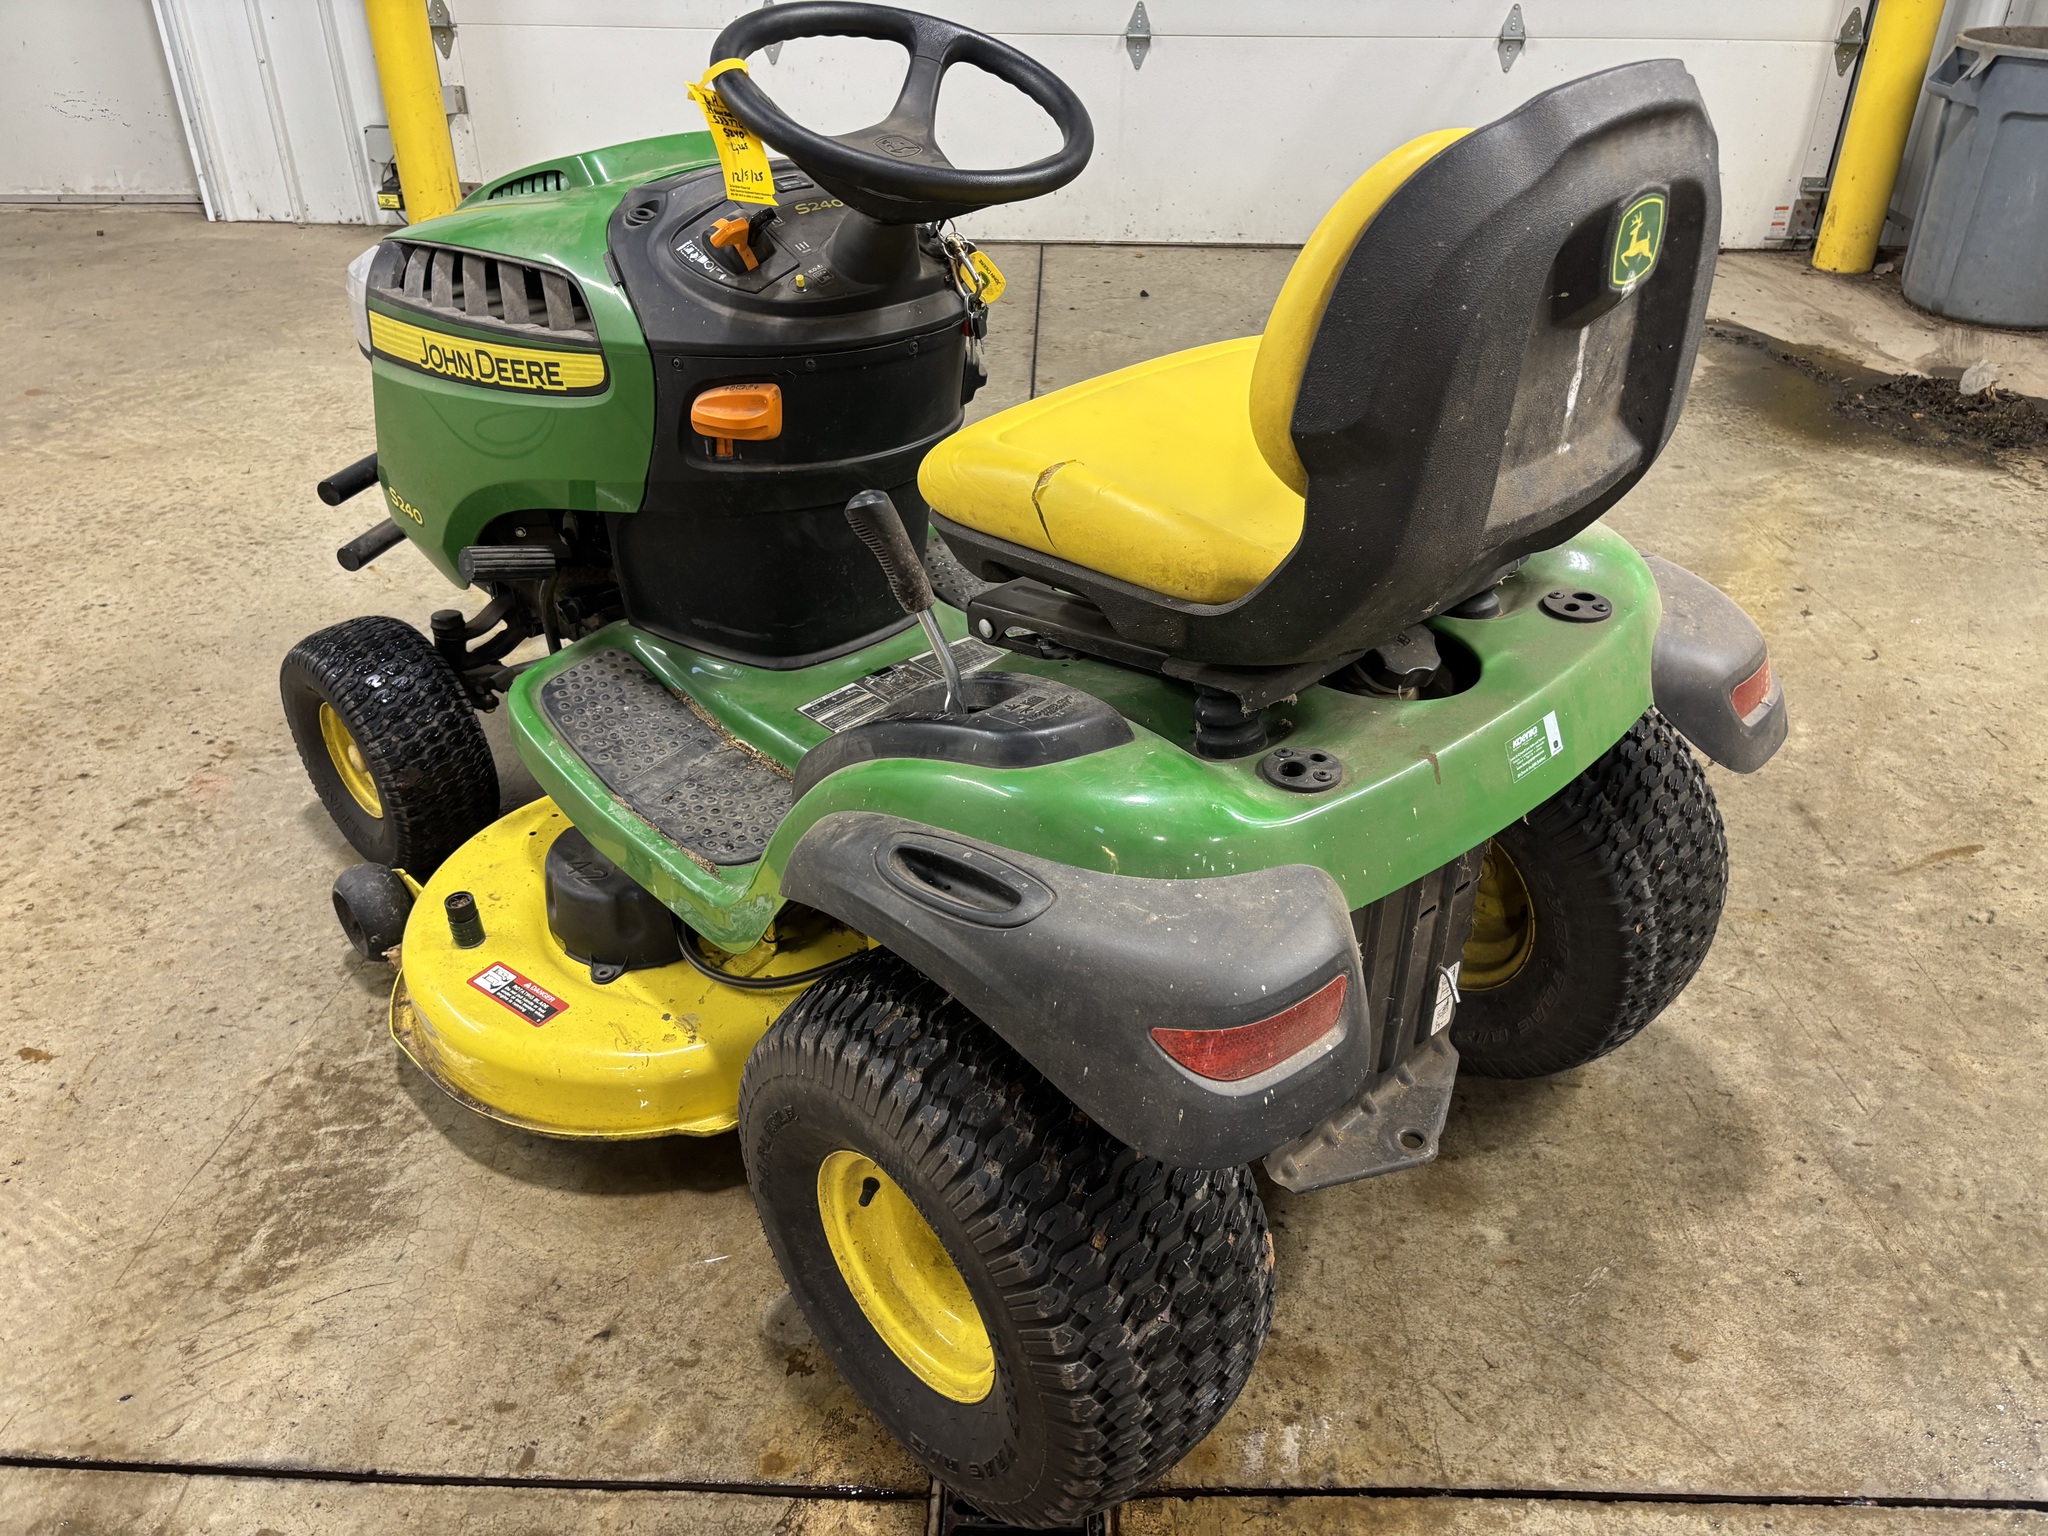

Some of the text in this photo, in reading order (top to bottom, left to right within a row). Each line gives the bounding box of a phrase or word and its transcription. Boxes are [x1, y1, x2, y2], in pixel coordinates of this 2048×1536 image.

[794, 199, 844, 215] S240
[420, 336, 564, 387] JOHN DEERE
[388, 487, 424, 526] S240
[566, 861, 608, 886] 42
[530, 985, 556, 1002] DANGER
